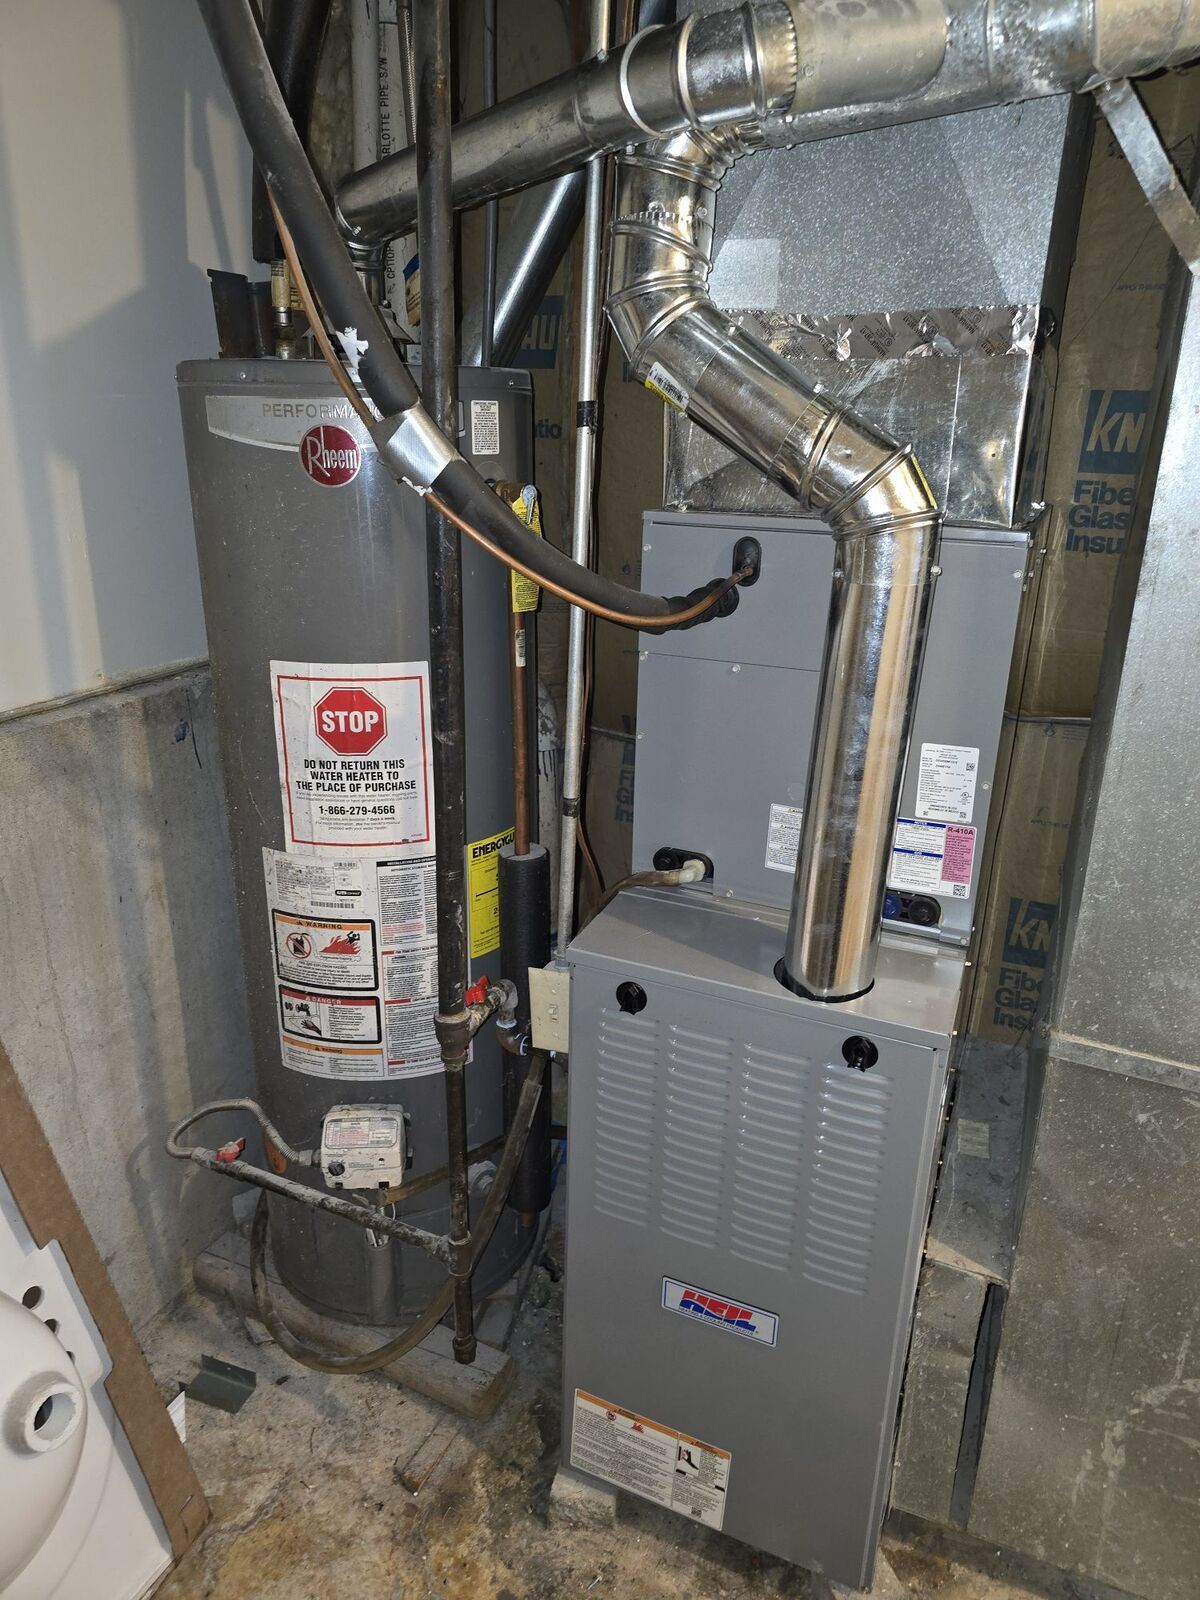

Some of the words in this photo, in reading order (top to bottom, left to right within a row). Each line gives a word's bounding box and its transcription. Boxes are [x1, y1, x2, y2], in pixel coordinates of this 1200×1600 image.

[379, 84, 389, 107] PIPE
[305, 426, 357, 477] Rheem
[1068, 504, 1131, 529] Glas
[321, 710, 379, 733] STOP
[304, 759, 316, 770] DO
[319, 760, 337, 770] NOT
[341, 760, 379, 770] RETURN
[382, 759, 405, 770] THIS
[310, 771, 343, 781] WATER
[346, 771, 384, 781] HEATER
[387, 770, 399, 781] TO
[296, 781, 313, 791] THE
[316, 782, 346, 792] PLACE
[349, 783, 361, 792] OF
[365, 780, 416, 792] PURCHASE
[318, 805, 395, 816] 1-866-279-4566
[947, 826, 974, 836] R-410A
[305, 921, 342, 930] WARNING
[312, 996, 341, 1005] DANGER
